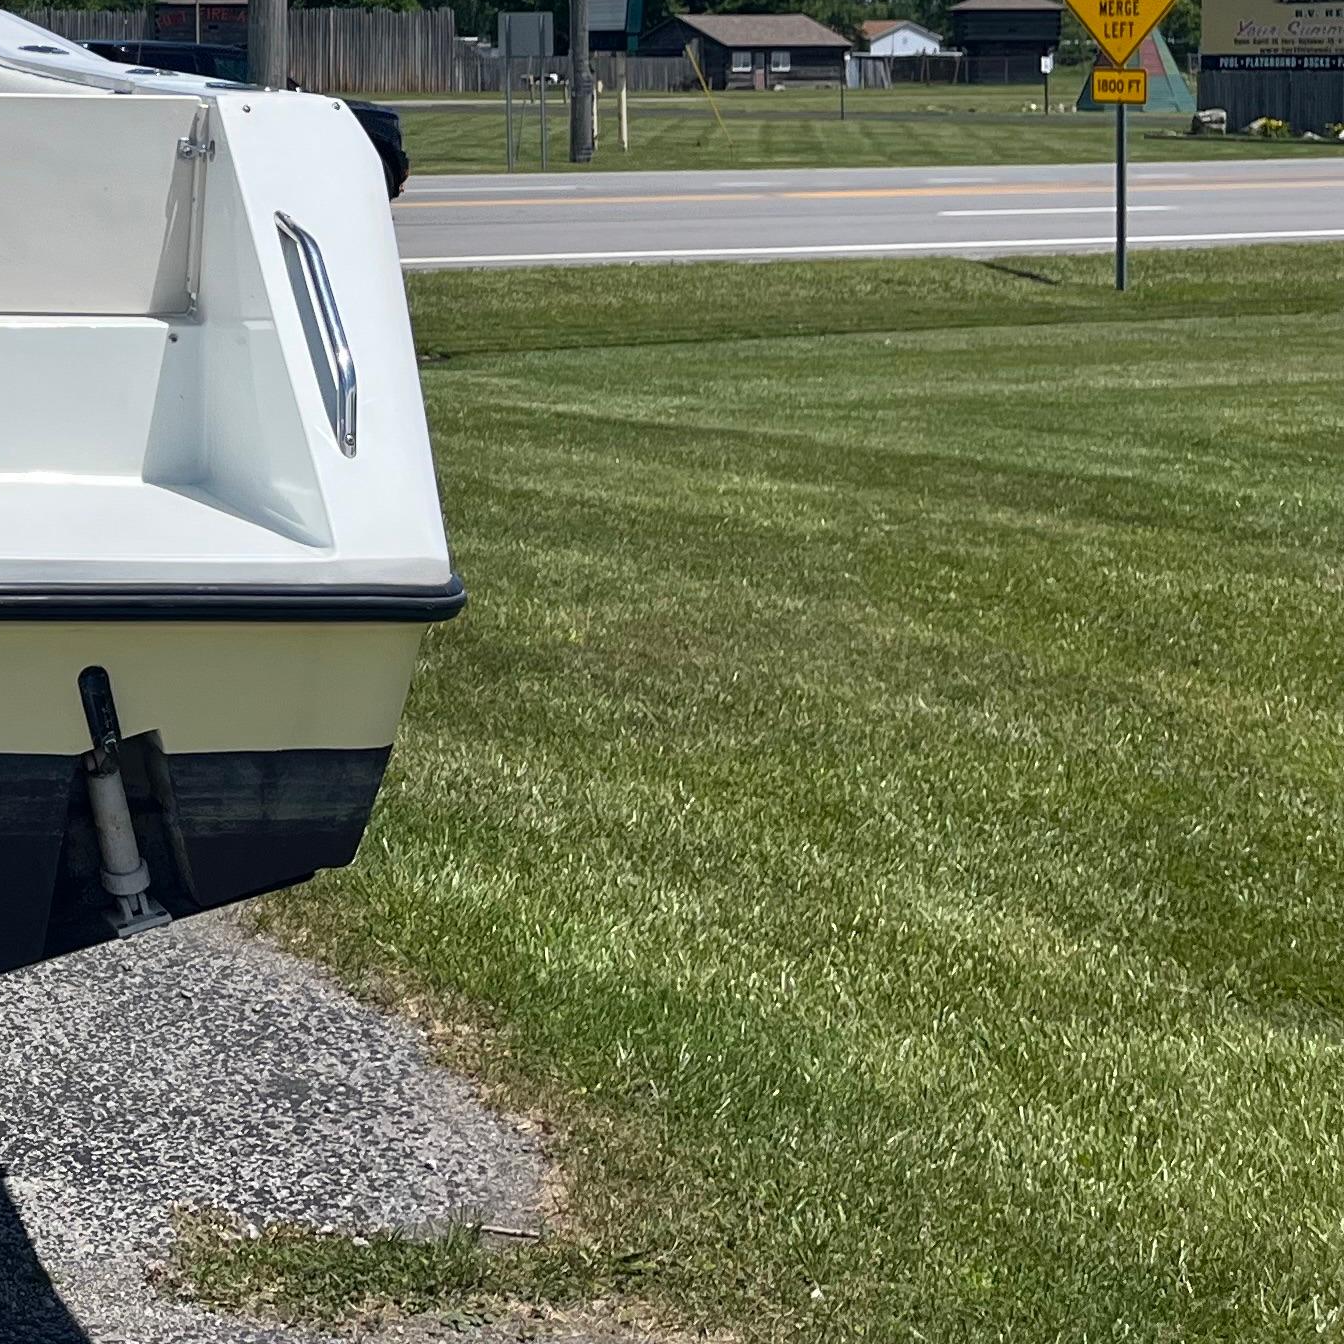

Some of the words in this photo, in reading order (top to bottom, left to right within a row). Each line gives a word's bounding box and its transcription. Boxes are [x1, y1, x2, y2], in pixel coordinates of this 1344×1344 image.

[1099, 0, 1139, 16] MERGE
[1104, 21, 1134, 38] LEFT
[1246, 57, 1297, 68] PLAYGROUND
[1097, 79, 1124, 93] 1800
[1128, 79, 1141, 93] FT
